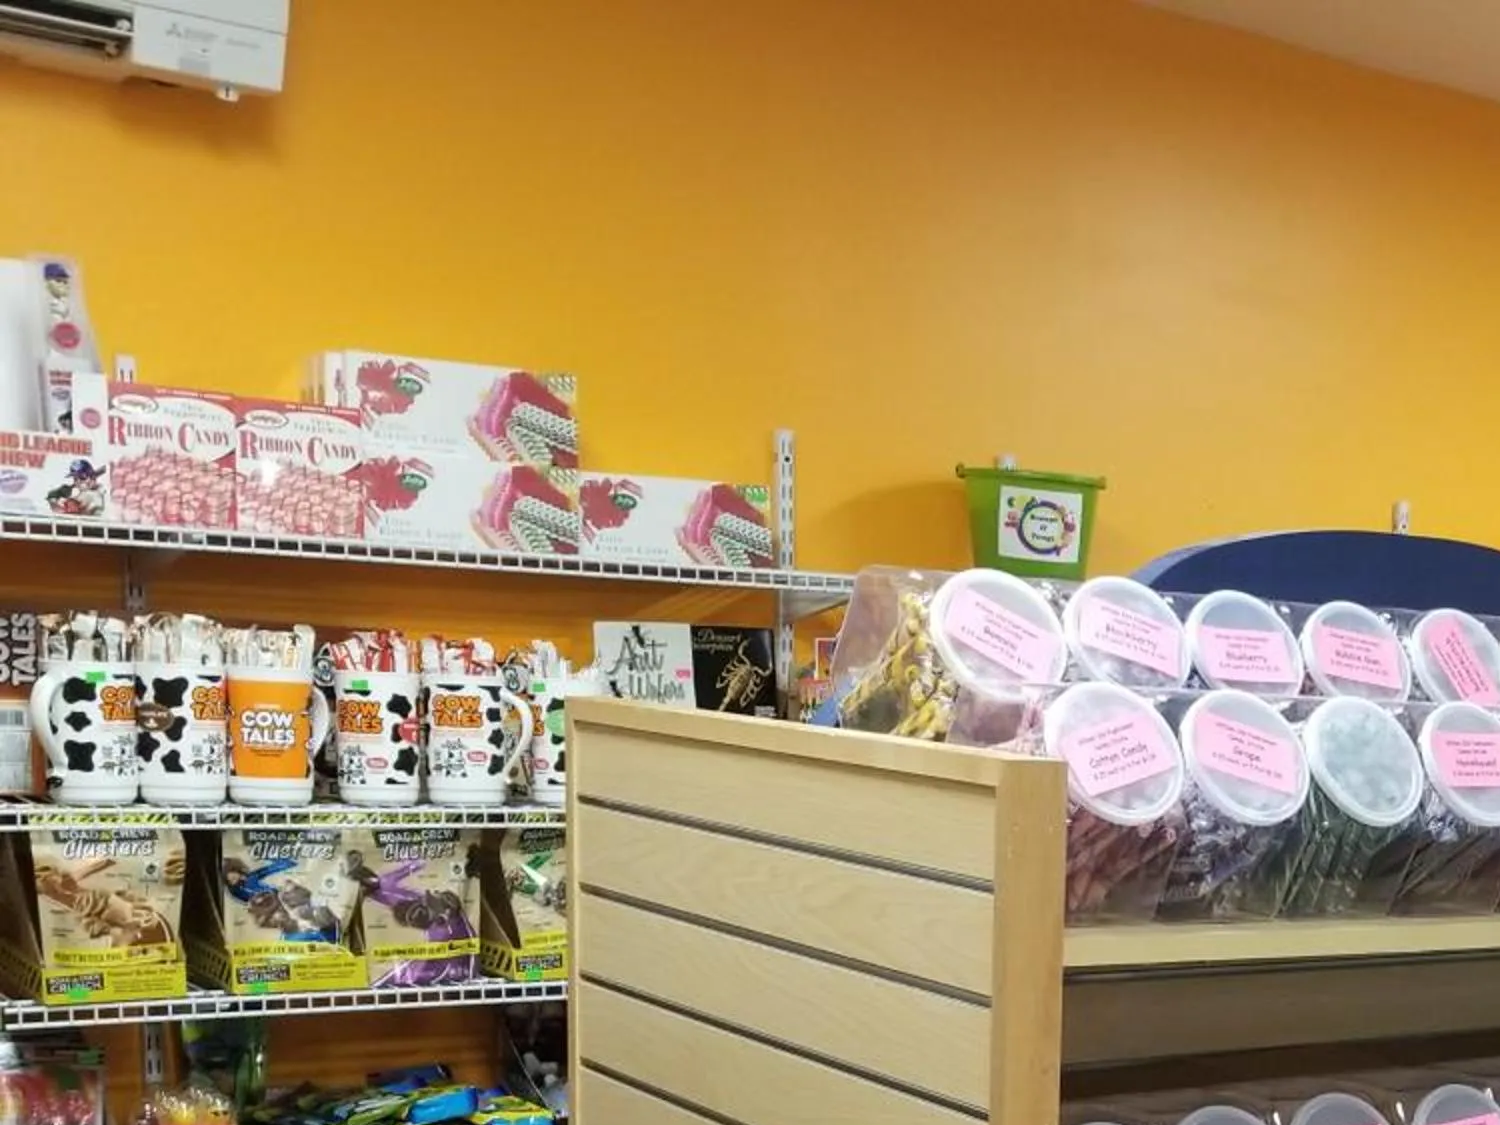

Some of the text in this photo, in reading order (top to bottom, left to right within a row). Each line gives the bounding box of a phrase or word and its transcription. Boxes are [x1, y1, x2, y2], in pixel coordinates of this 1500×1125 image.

[107, 415, 230, 454] RIBBON CANDY
[23, 436, 92, 456] LEAGUE
[239, 429, 358, 467] RIBBON CANDY
[0, 452, 46, 469] HEW
[11, 612, 38, 685] TALES
[606, 636, 667, 675] Ant
[338, 701, 381, 716] COW
[433, 695, 480, 710] COW
[241, 711, 293, 727] COW
[338, 716, 383, 734] TALES
[433, 710, 483, 727] TALES
[241, 727, 295, 745] TALES
[63, 839, 155, 859] Clusters
[252, 841, 334, 860] Clusters
[383, 841, 455, 860] Clusters
